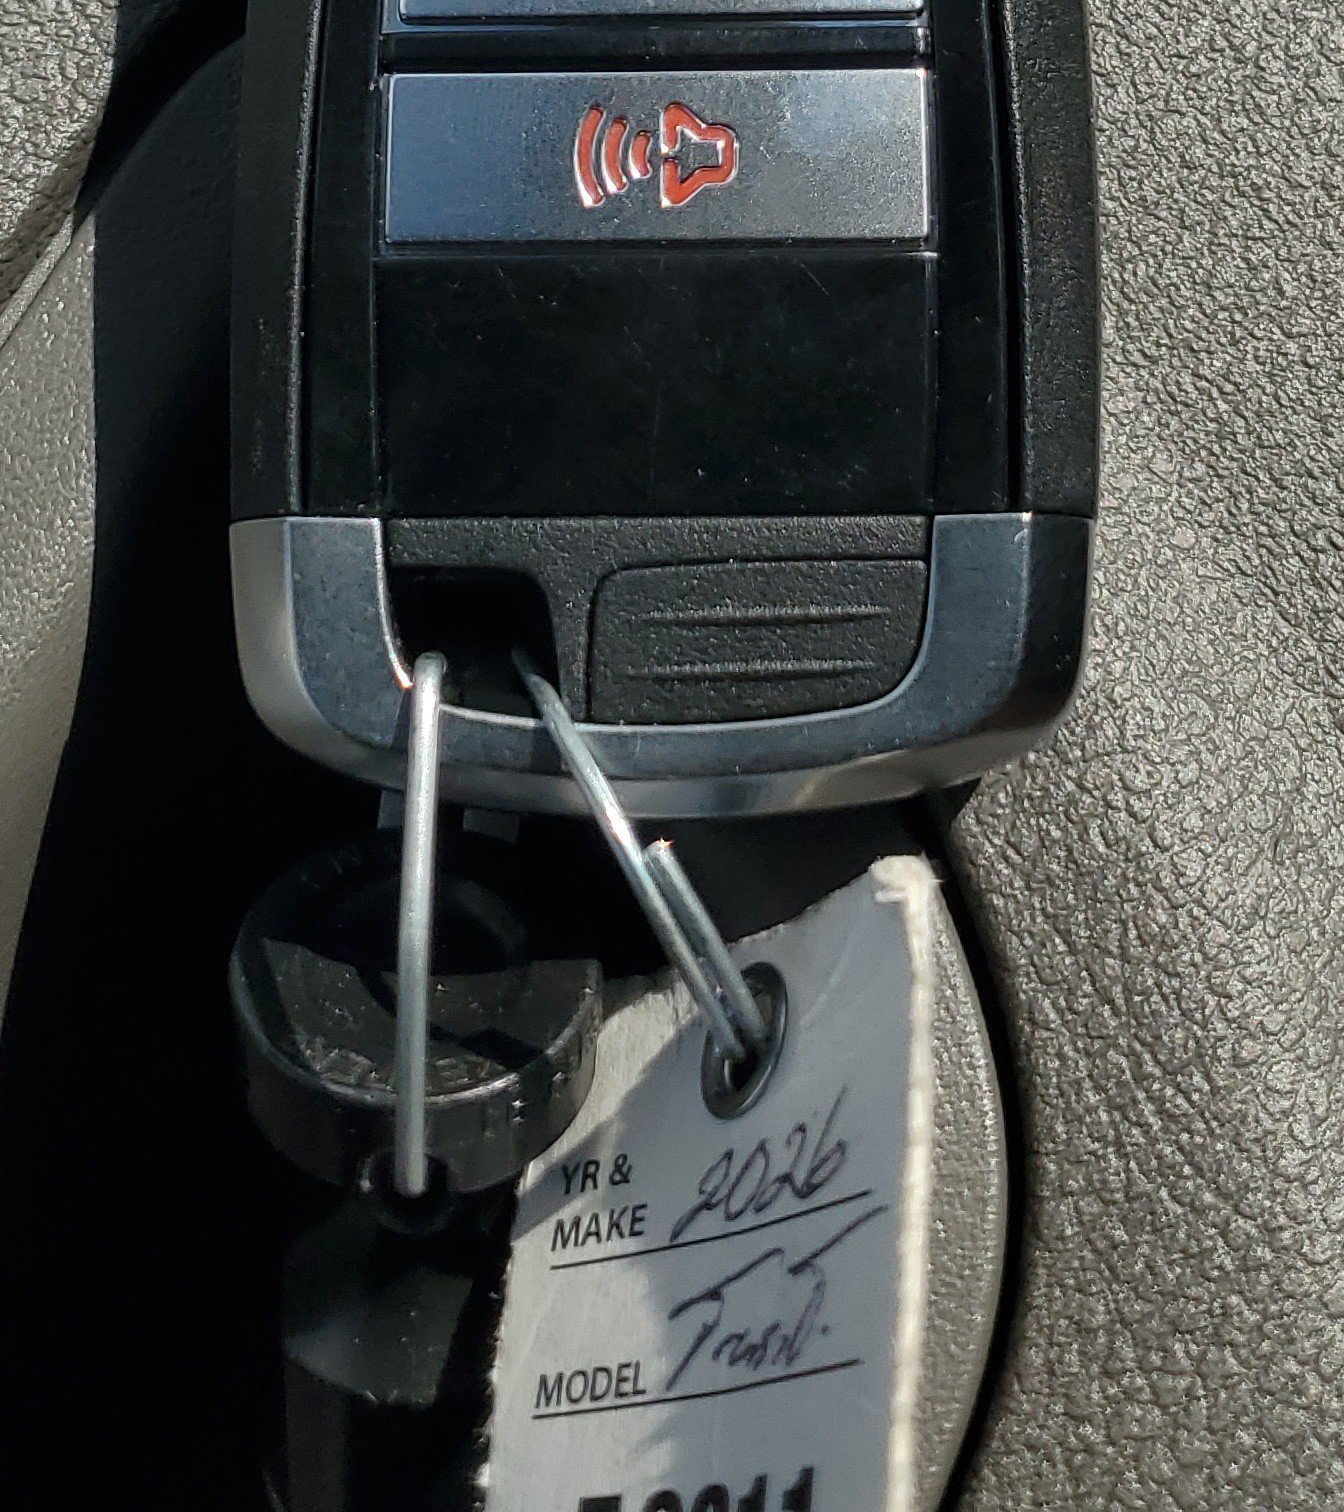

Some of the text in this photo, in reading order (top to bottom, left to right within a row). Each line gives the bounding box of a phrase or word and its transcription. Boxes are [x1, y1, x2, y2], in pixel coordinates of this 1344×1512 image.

[560, 1153, 632, 1194] YR &
[669, 1087, 847, 1243] 2026
[550, 1203, 649, 1252] MAKE
[535, 1360, 647, 1409] MODEL
